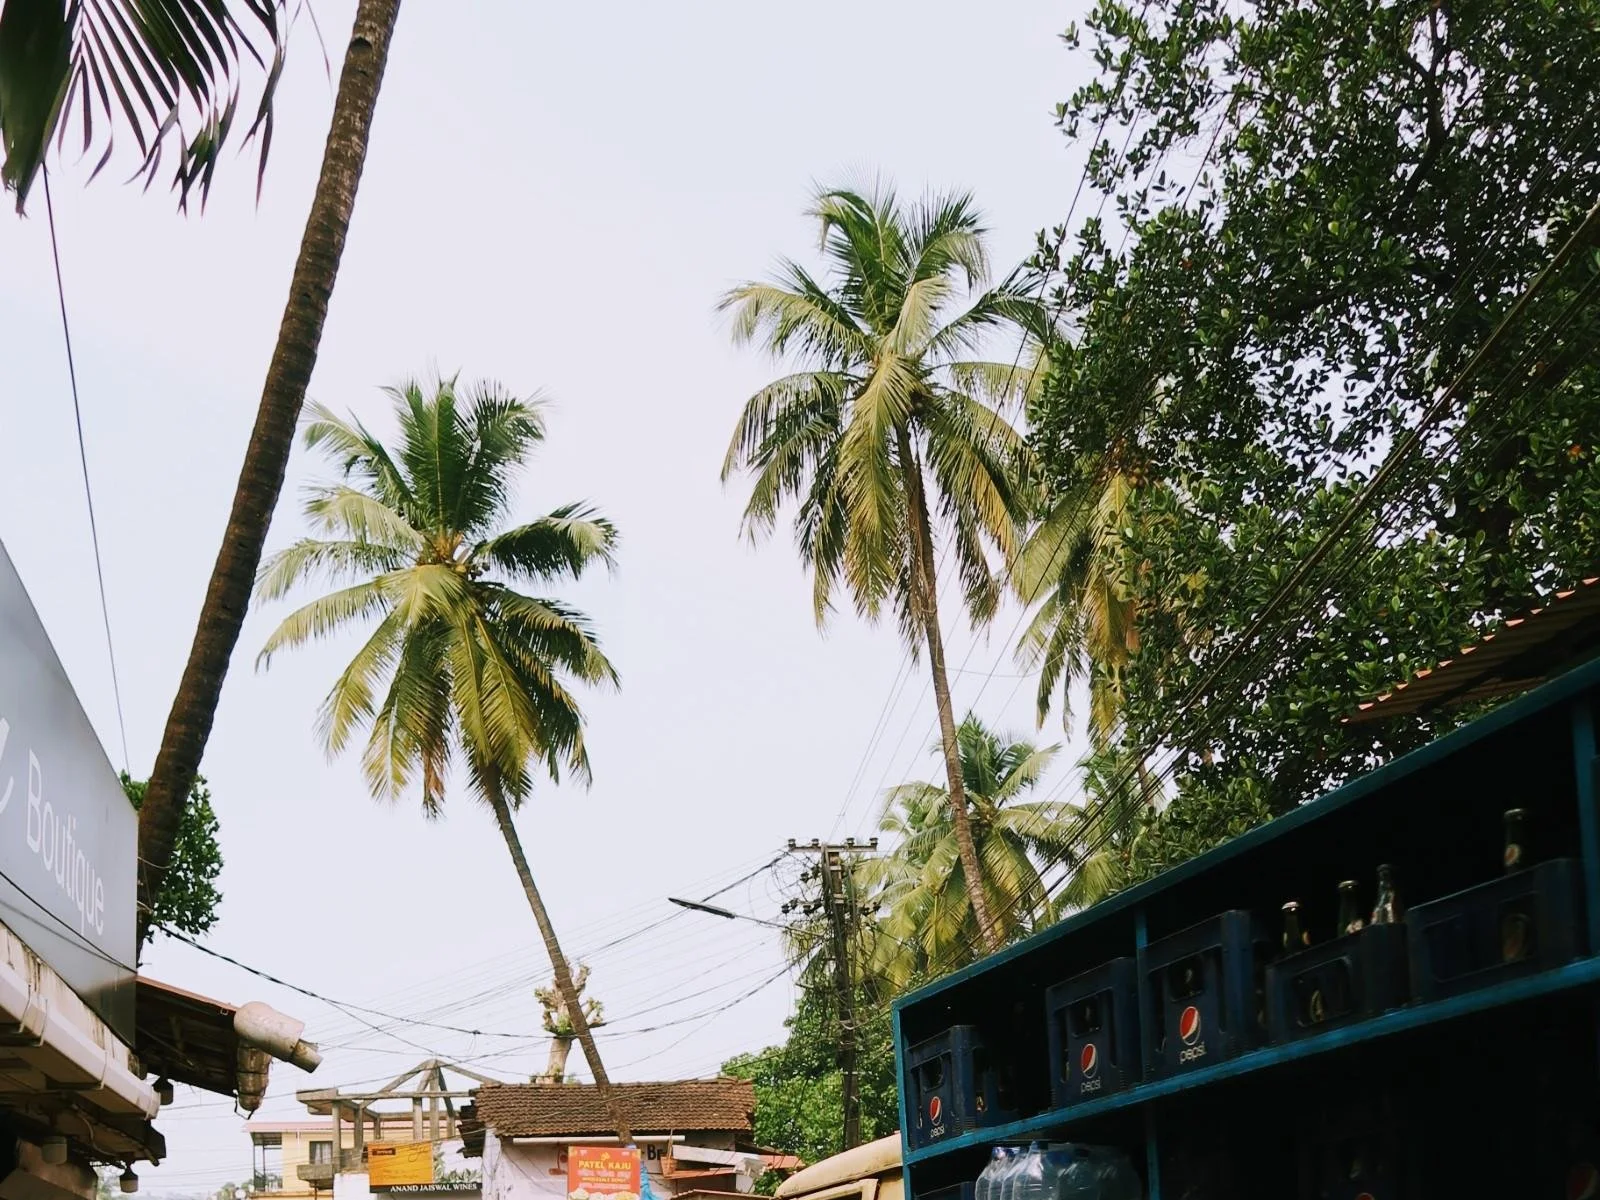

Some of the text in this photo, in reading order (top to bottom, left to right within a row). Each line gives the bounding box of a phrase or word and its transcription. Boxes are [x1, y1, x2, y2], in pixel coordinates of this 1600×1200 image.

[26, 748, 105, 937] Boutique
[1179, 1041, 1207, 1065] pepsi
[1080, 1075, 1101, 1096] pepsi
[578, 1161, 631, 1170] PATEL KAJU
[390, 1183, 477, 1193] ANAND JAISWAL WINES
